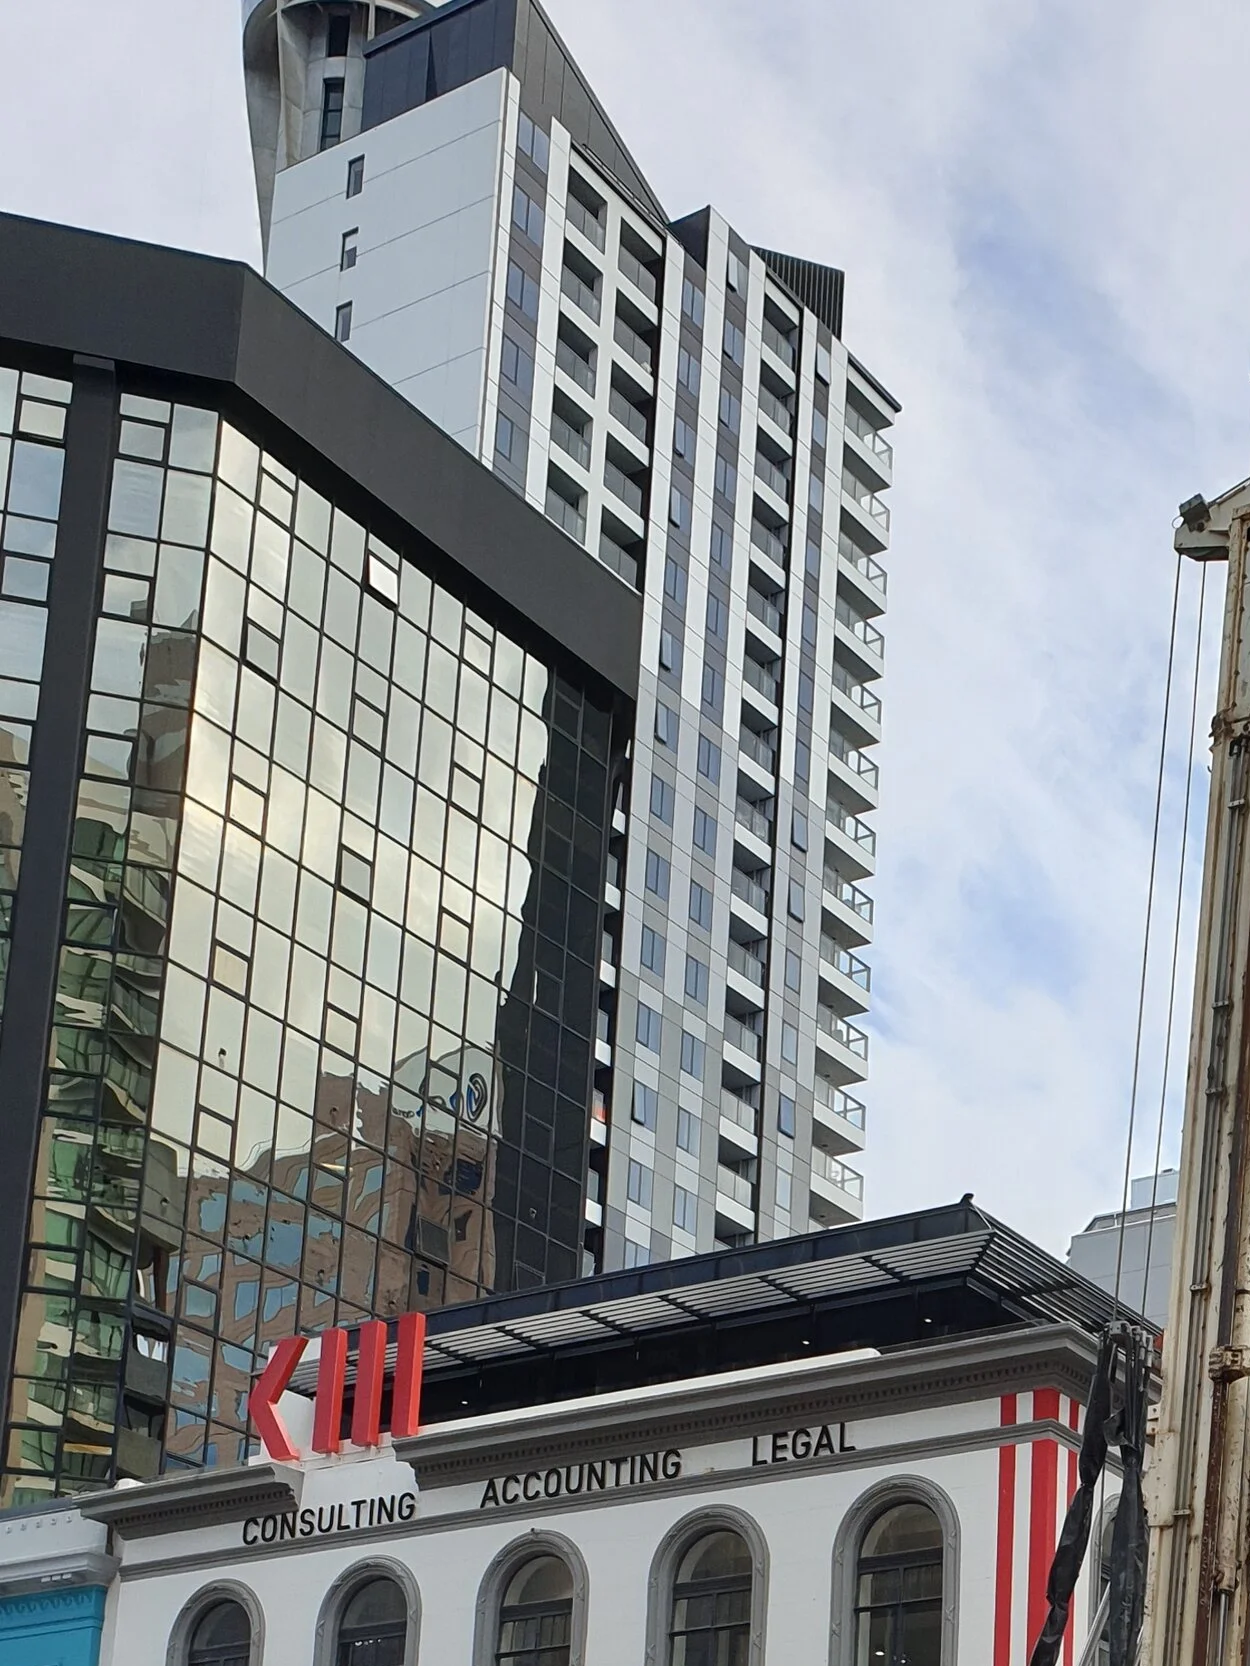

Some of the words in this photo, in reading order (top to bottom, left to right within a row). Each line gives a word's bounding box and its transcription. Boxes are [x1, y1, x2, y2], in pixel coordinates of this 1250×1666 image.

[242, 1491, 417, 1546] CONSULTING
[480, 1449, 682, 1509] ACCOUNTING
[751, 1422, 856, 1467] LEGAL
